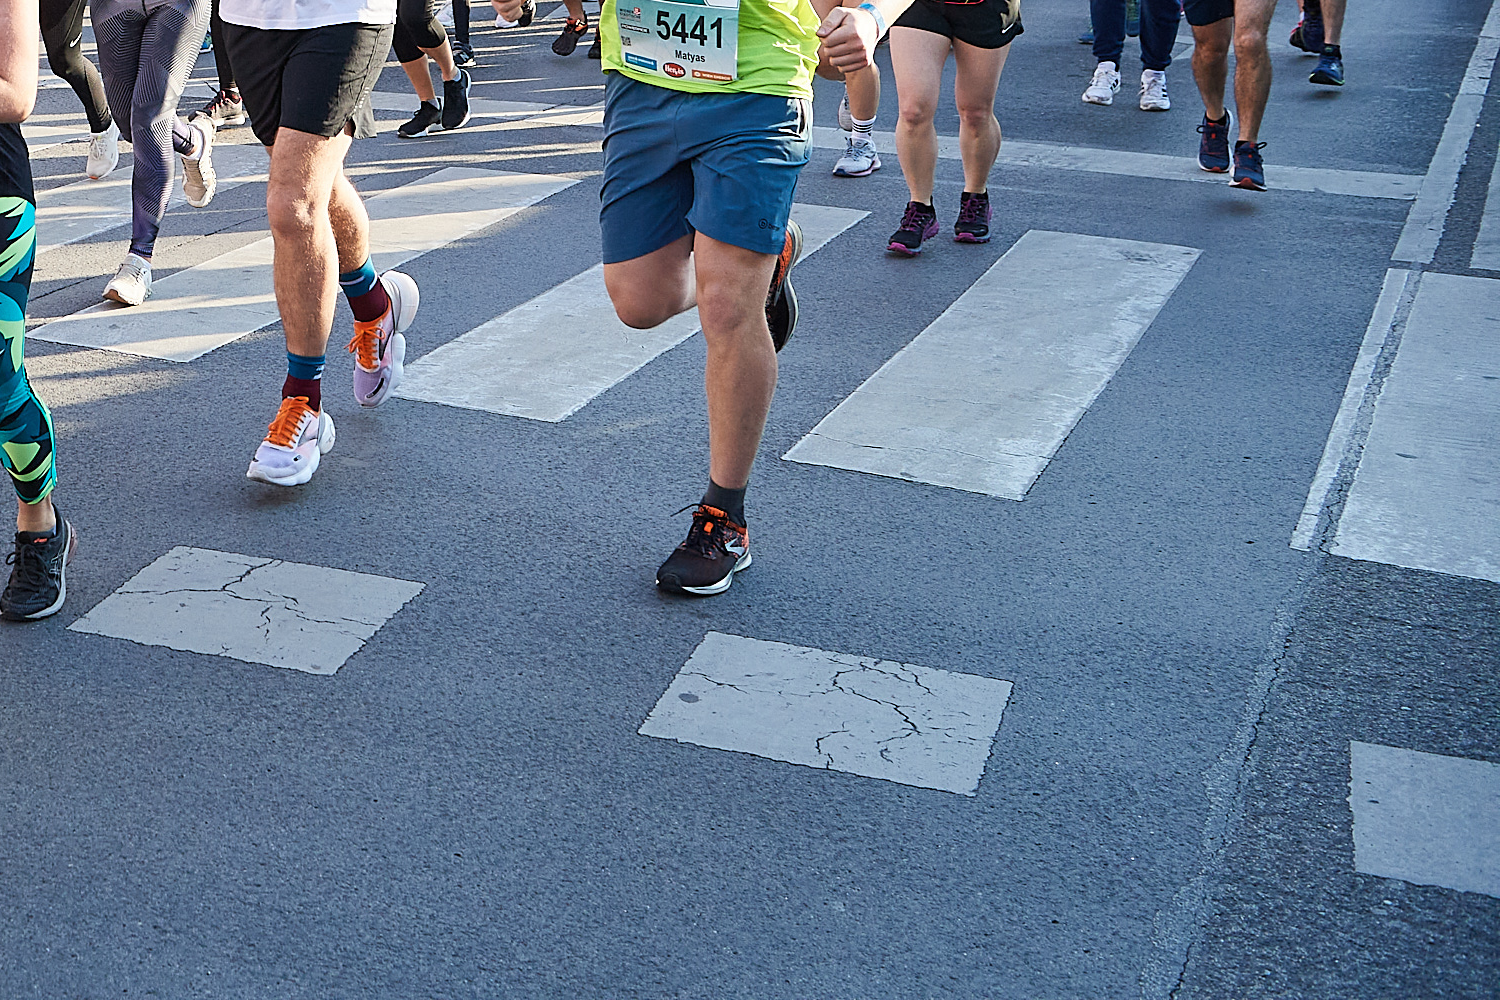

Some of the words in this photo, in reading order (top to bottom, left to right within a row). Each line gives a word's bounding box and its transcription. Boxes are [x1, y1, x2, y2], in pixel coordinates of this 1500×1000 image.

[656, 9, 723, 49] 5441
[675, 49, 706, 63] Matyas
[664, 64, 685, 76] Hervis
